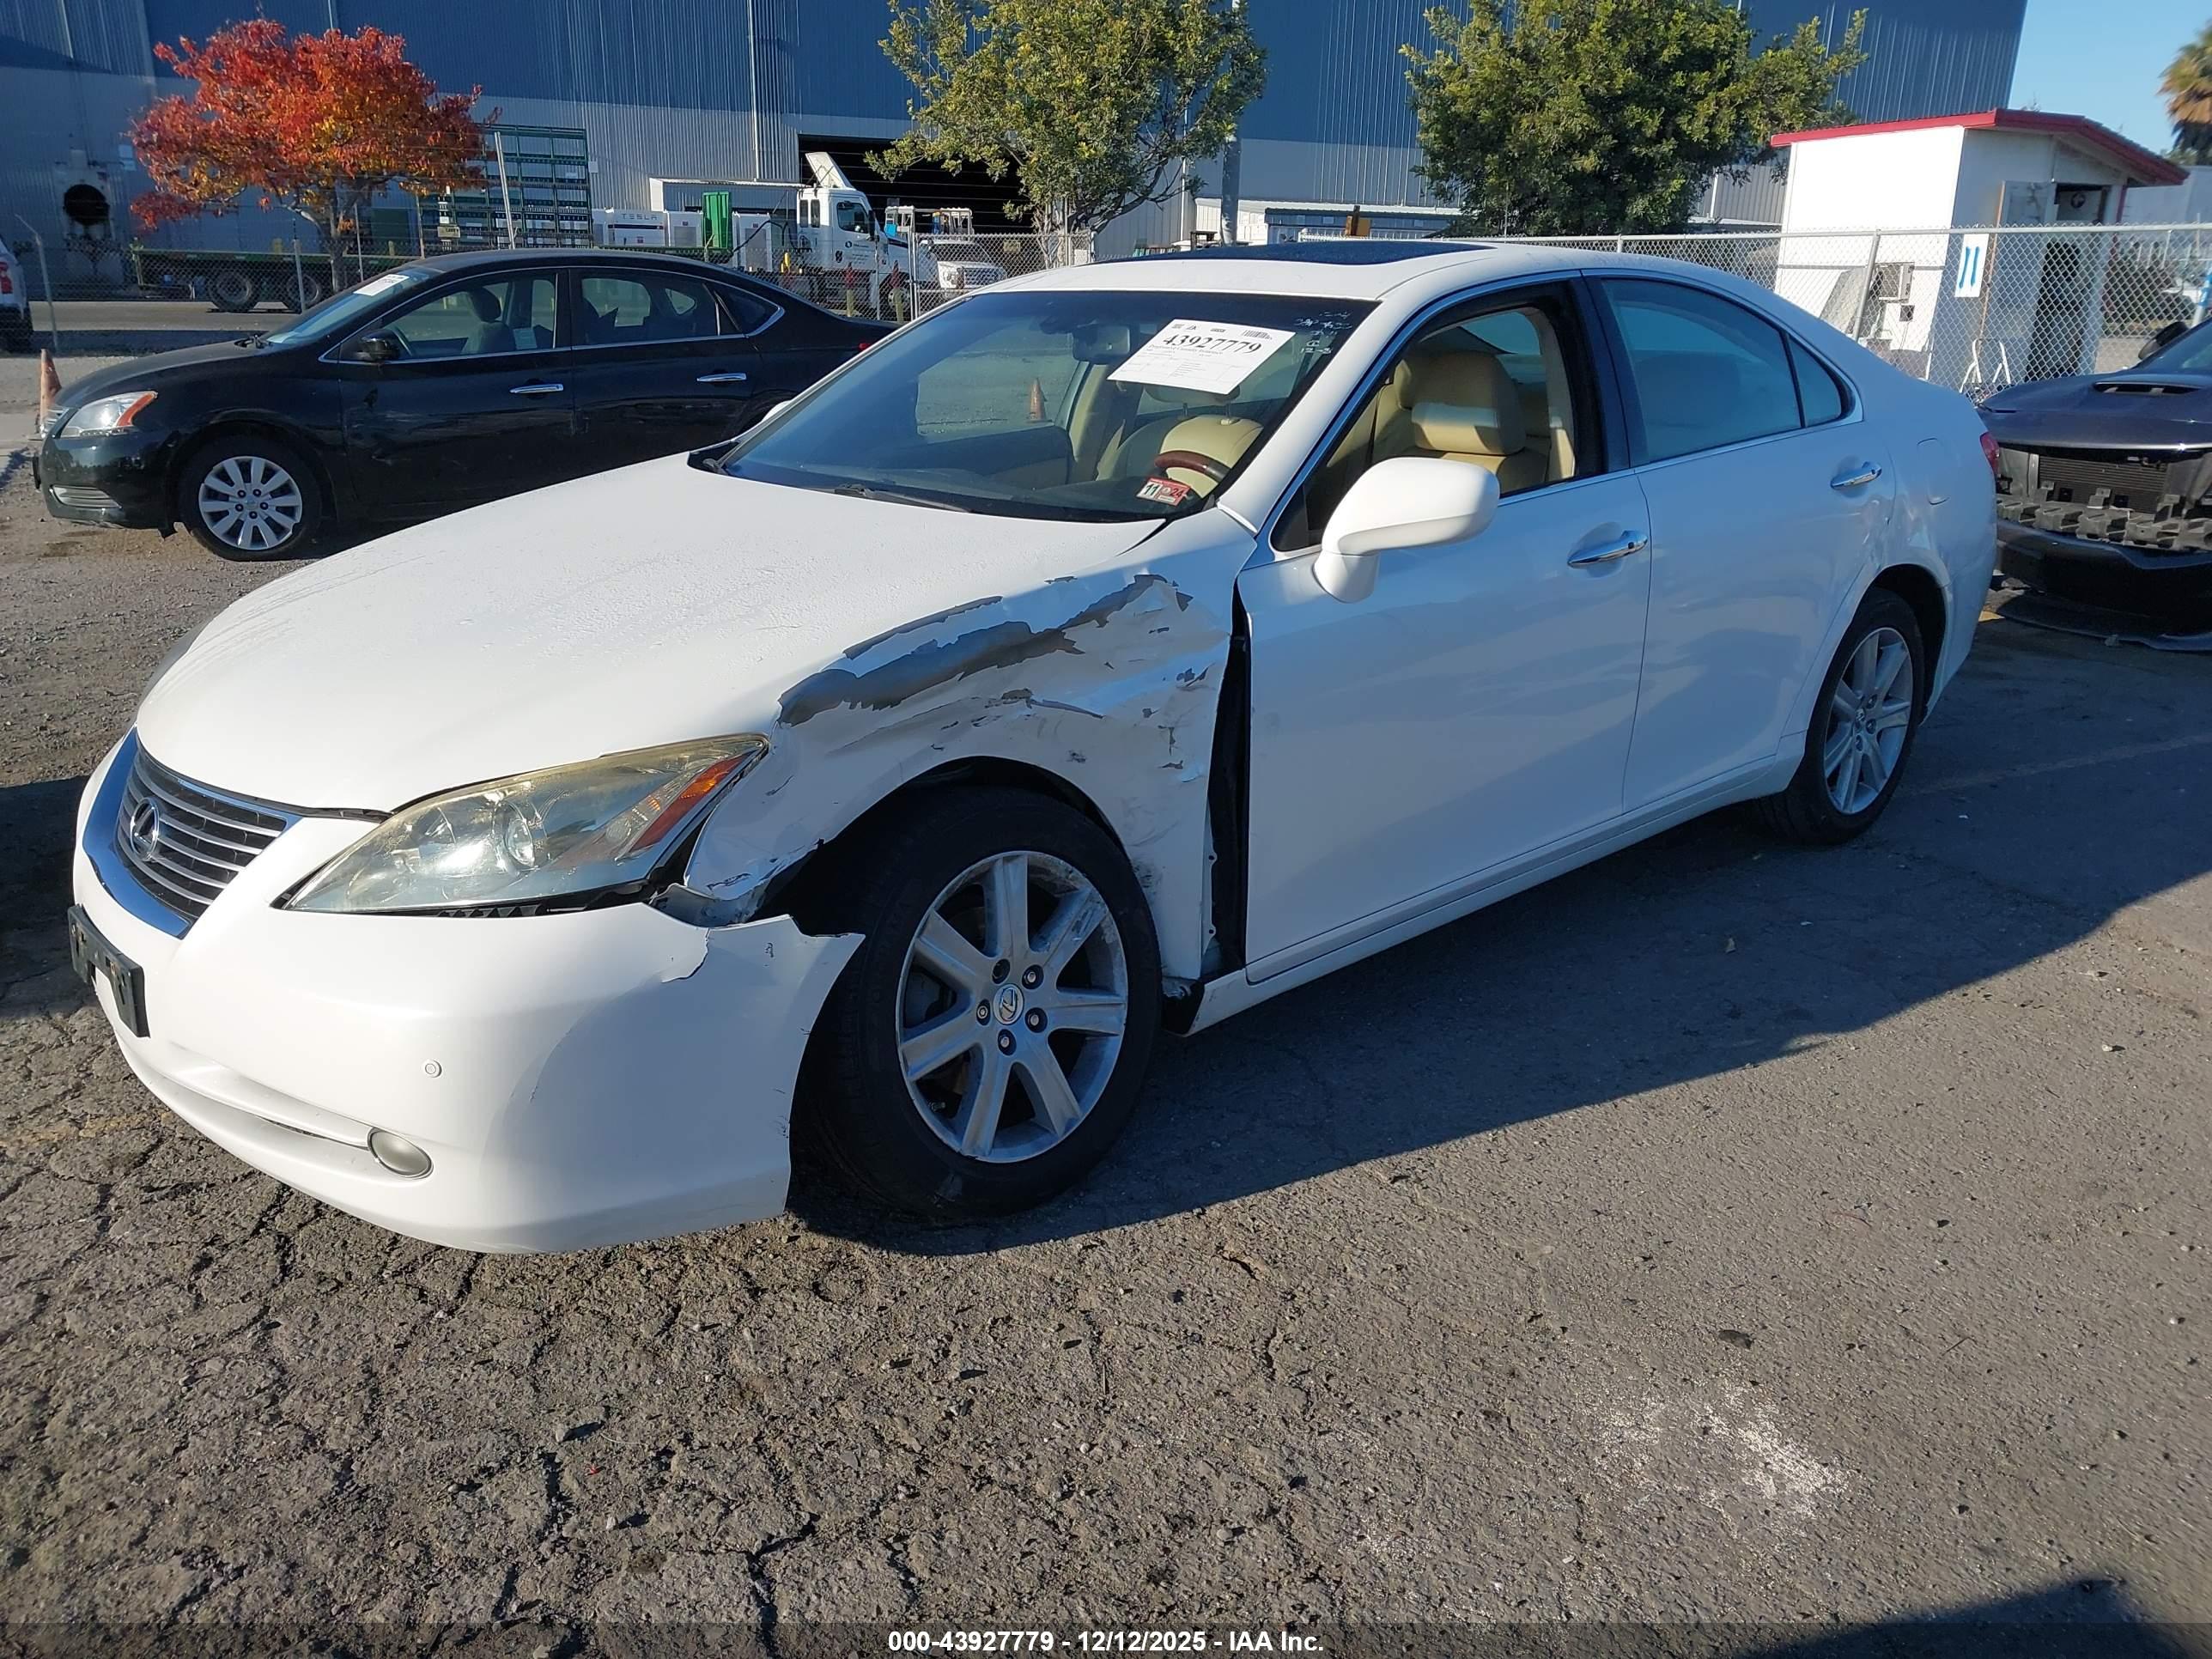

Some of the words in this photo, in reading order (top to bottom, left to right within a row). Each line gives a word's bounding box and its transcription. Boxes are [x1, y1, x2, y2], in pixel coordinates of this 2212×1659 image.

[1163, 333, 1262, 354] 43927779
[1144, 483, 1160, 496] 11
[1169, 488, 1184, 498] 24
